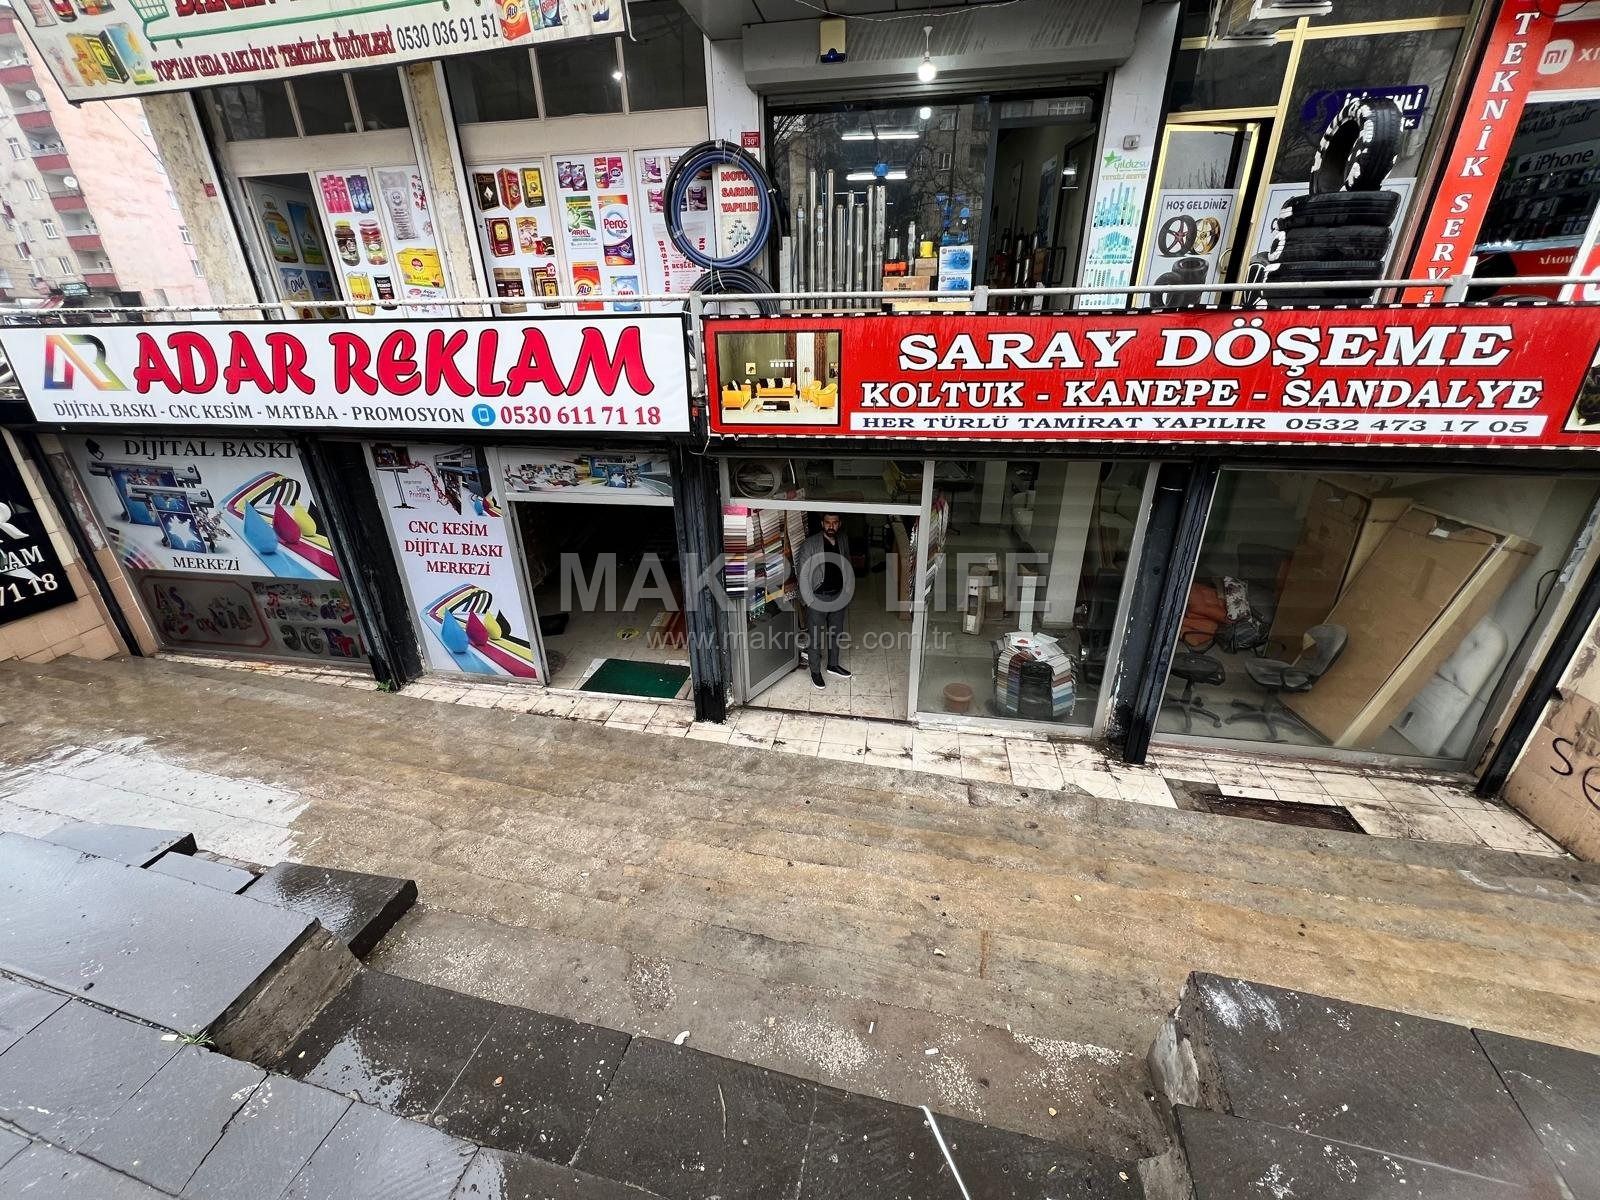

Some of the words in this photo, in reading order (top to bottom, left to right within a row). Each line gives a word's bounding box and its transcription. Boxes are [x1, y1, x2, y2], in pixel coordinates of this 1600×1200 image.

[151, 56, 198, 82] TOPTAN
[195, 53, 226, 77] GIDA
[333, 24, 396, 60] ÜRÜNLERİ
[396, 19, 431, 51] 0530
[431, 19, 459, 46] 036
[460, 17, 479, 42] 91
[482, 14, 498, 39] 51
[1459, 12, 1540, 177] TEKNİK
[1534, 150, 1594, 171] iPhone
[721, 202, 759, 212] YAPILIR
[1166, 201, 1185, 212] HOŞ
[1186, 198, 1228, 210] GELDİNİZ
[603, 219, 627, 229] Peros
[899, 329, 1137, 371] SARAY
[1155, 318, 1513, 377] DÖŞEME
[133, 330, 316, 394] ADAR
[328, 325, 655, 397] REKLAM
[860, 381, 1027, 408] KOLTUK
[1063, 379, 1239, 408] KANEPE
[1282, 378, 1544, 409] SANDALYE
[54, 400, 109, 419] DİJİTAL
[111, 403, 157, 417] BASKI
[168, 404, 200, 418] CNC
[201, 402, 254, 419] KESİM
[265, 404, 338, 419] MATBAA
[352, 406, 465, 423] PROMOSYON
[500, 406, 550, 424] 0530
[557, 406, 596, 424] 611
[602, 406, 628, 424] 71
[634, 406, 661, 425] 18
[863, 417, 915, 429] HER
[924, 414, 1010, 429] TÜRLÜ
[1019, 414, 1143, 429] TAMİRAT
[1154, 417, 1266, 429] YAPILIR
[1286, 418, 1358, 431] 0532
[1370, 419, 1426, 432] 473
[1441, 420, 1480, 432] 17
[1488, 420, 1529, 433] 05
[124, 439, 215, 460] DİJİTAL
[222, 441, 294, 459] BASKI
[409, 521, 439, 534] CNC
[442, 521, 488, 536] KESİM
[405, 538, 458, 556] DİJİTAL
[462, 543, 503, 557] BASKI
[172, 557, 240, 571] MERKEZİ
[427, 561, 490, 576] MERKEZİ
[28, 573, 58, 596] 18
